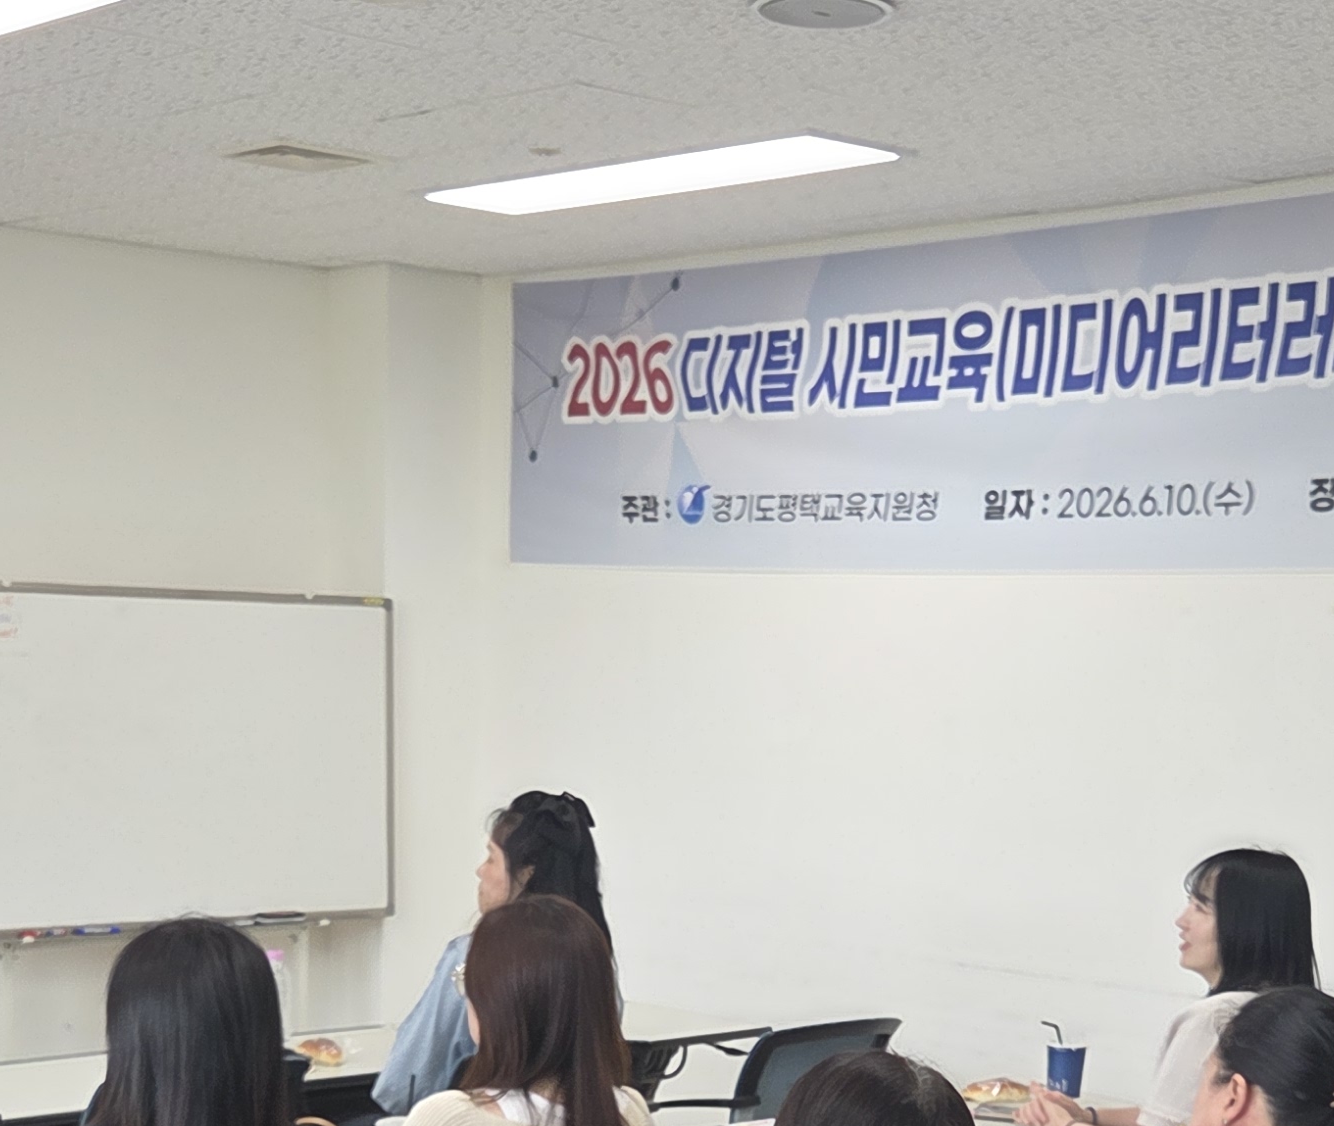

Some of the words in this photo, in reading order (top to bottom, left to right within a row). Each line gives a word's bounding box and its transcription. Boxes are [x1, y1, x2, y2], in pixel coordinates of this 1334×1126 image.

[567, 341, 674, 418] 2026
[680, 328, 804, 414] 디지털
[712, 491, 940, 524] 경기도평택교육지원청
